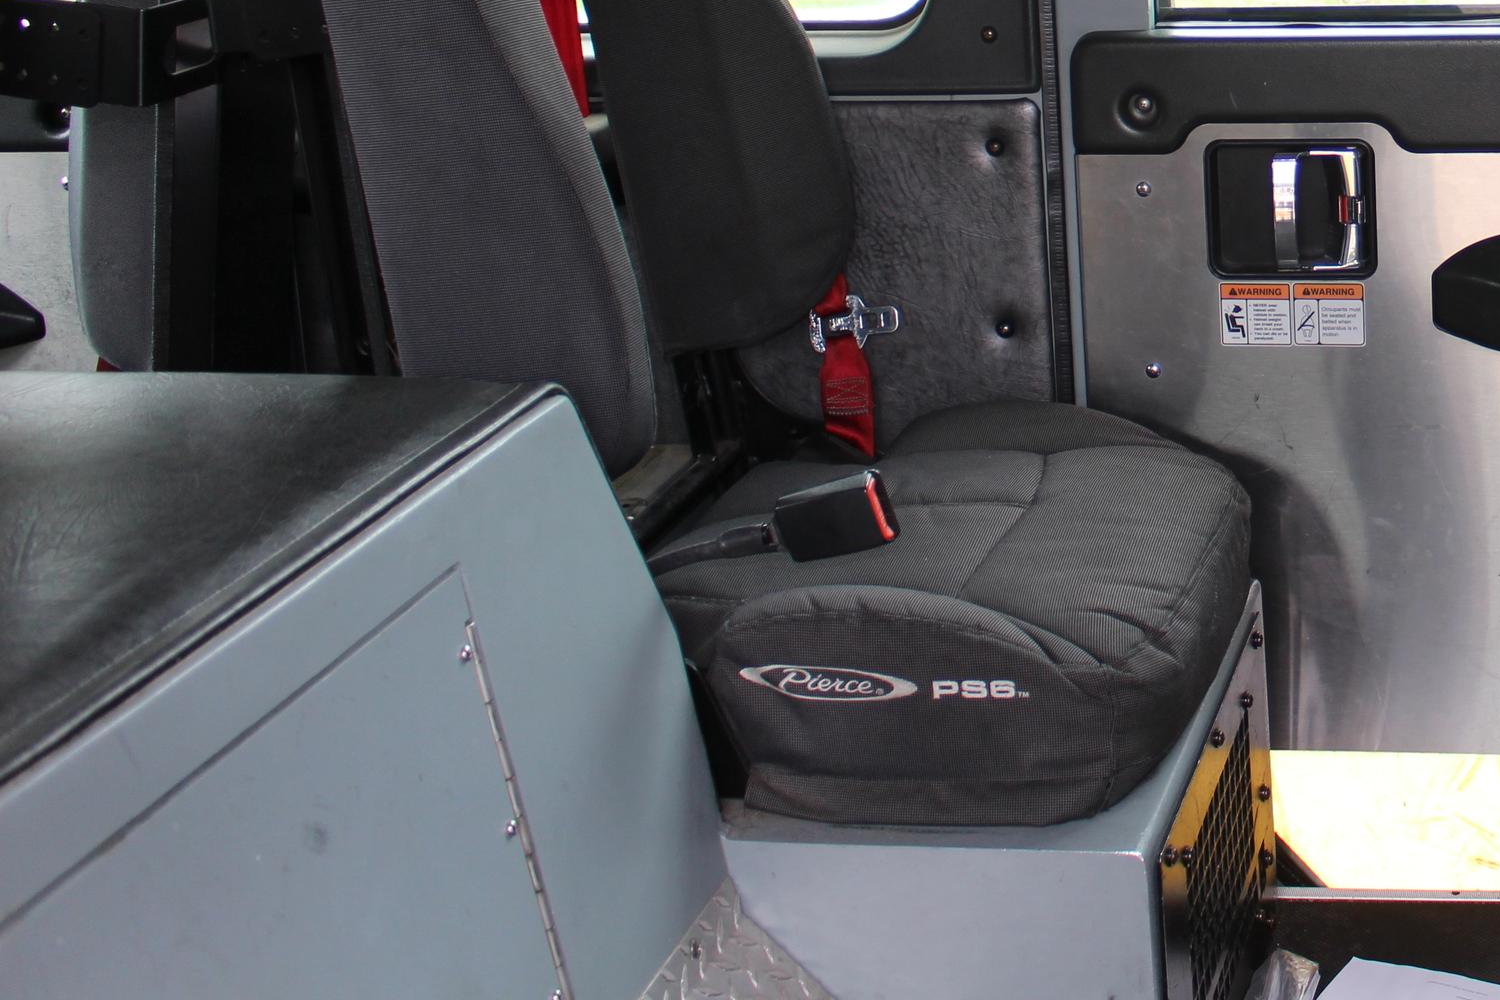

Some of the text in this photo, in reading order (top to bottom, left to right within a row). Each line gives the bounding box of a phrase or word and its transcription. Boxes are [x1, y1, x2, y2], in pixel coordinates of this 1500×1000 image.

[1237, 287, 1282, 296] WARNING
[1310, 287, 1355, 296] WARNING
[777, 667, 875, 696] Pierce
